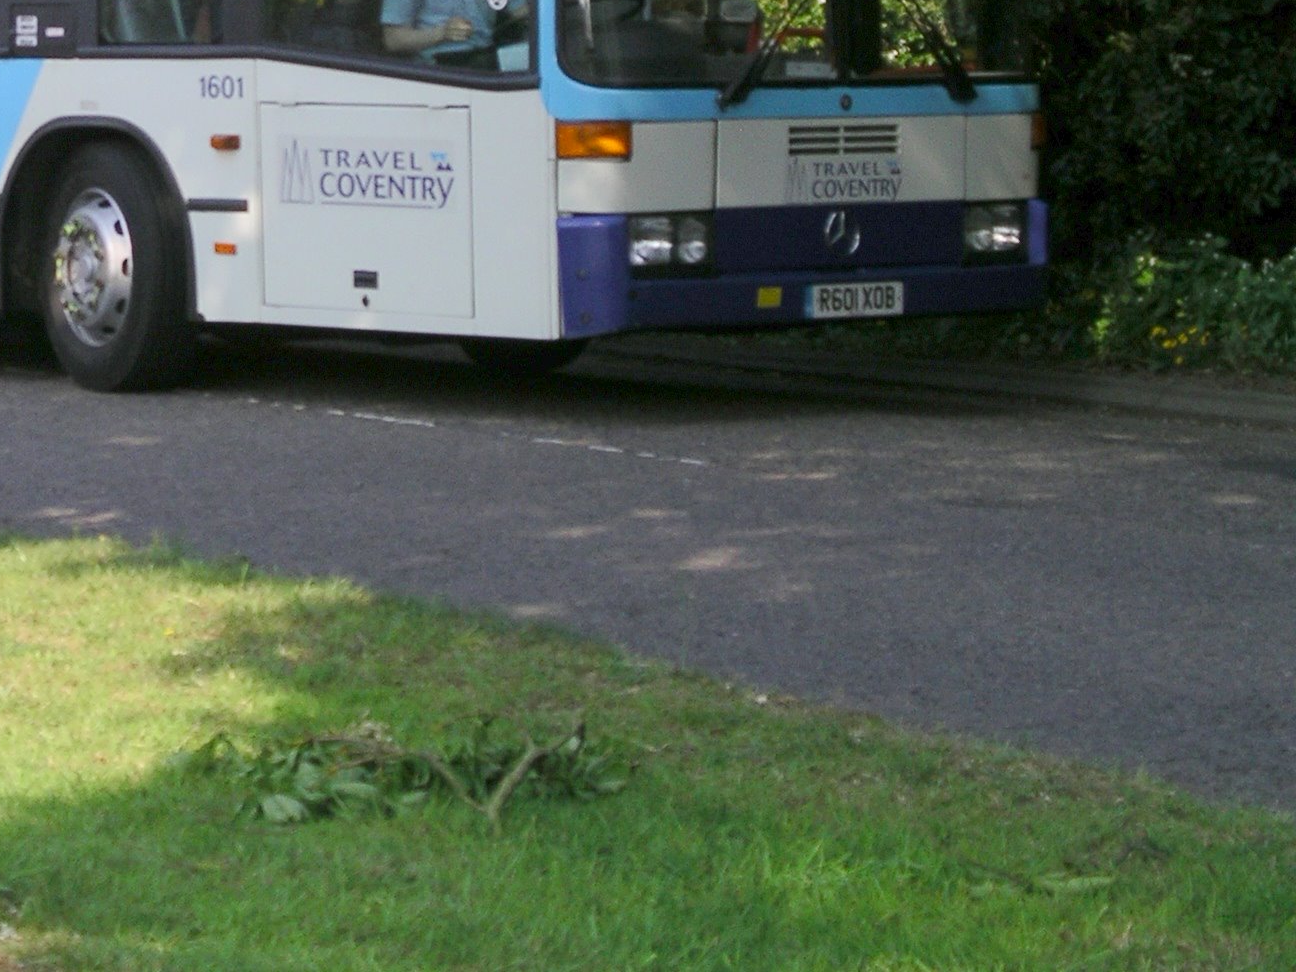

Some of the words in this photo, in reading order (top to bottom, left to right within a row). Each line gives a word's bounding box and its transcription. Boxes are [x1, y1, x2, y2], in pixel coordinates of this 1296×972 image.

[200, 75, 244, 99] 1601
[320, 149, 422, 171] TRAVEL
[813, 162, 881, 176] TRAVEL
[320, 172, 454, 208] COVENTRY
[812, 178, 903, 203] COVENTRY
[862, 285, 896, 310] XOB
